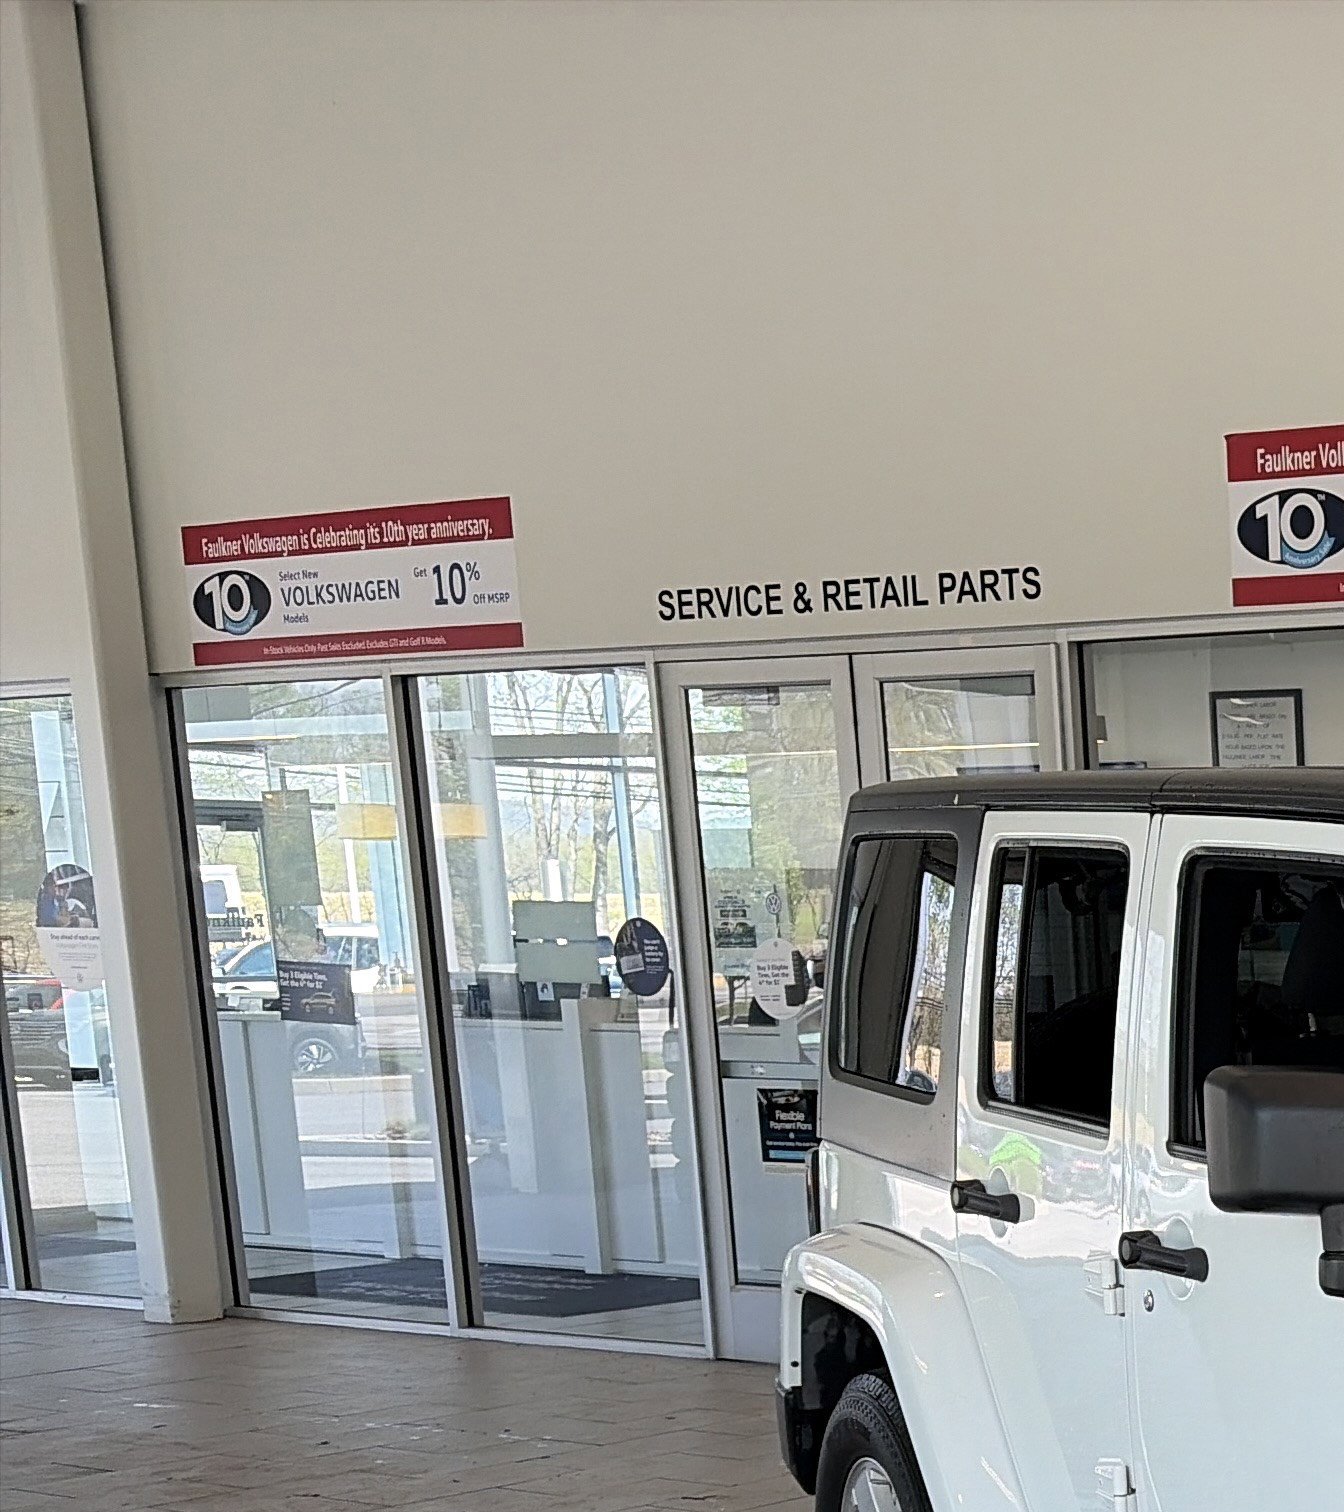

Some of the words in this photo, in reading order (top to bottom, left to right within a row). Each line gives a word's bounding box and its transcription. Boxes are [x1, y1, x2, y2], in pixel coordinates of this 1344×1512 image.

[1256, 446, 1317, 473] Faulkner
[201, 536, 241, 558] Faulkner
[241, 532, 299, 557] Volkswagen
[299, 528, 309, 550] is
[309, 524, 366, 550] Celebrating
[381, 519, 406, 543] 10th
[406, 523, 428, 546] year
[429, 514, 493, 540] anniversary.
[1255, 492, 1325, 561] 10
[278, 570, 301, 581] Select
[301, 569, 319, 580] New
[413, 566, 428, 578] Get
[432, 561, 481, 606] 10%
[280, 578, 401, 607] VOLKSWAGEN
[473, 593, 486, 605] Off
[487, 592, 510, 604] MSRP
[657, 583, 784, 622] SERVICE
[793, 581, 814, 614] &
[821, 575, 929, 613] RETAIL
[938, 566, 1042, 605] PARTS
[282, 612, 309, 624] Models
[774, 1109, 806, 1121] Flexible
